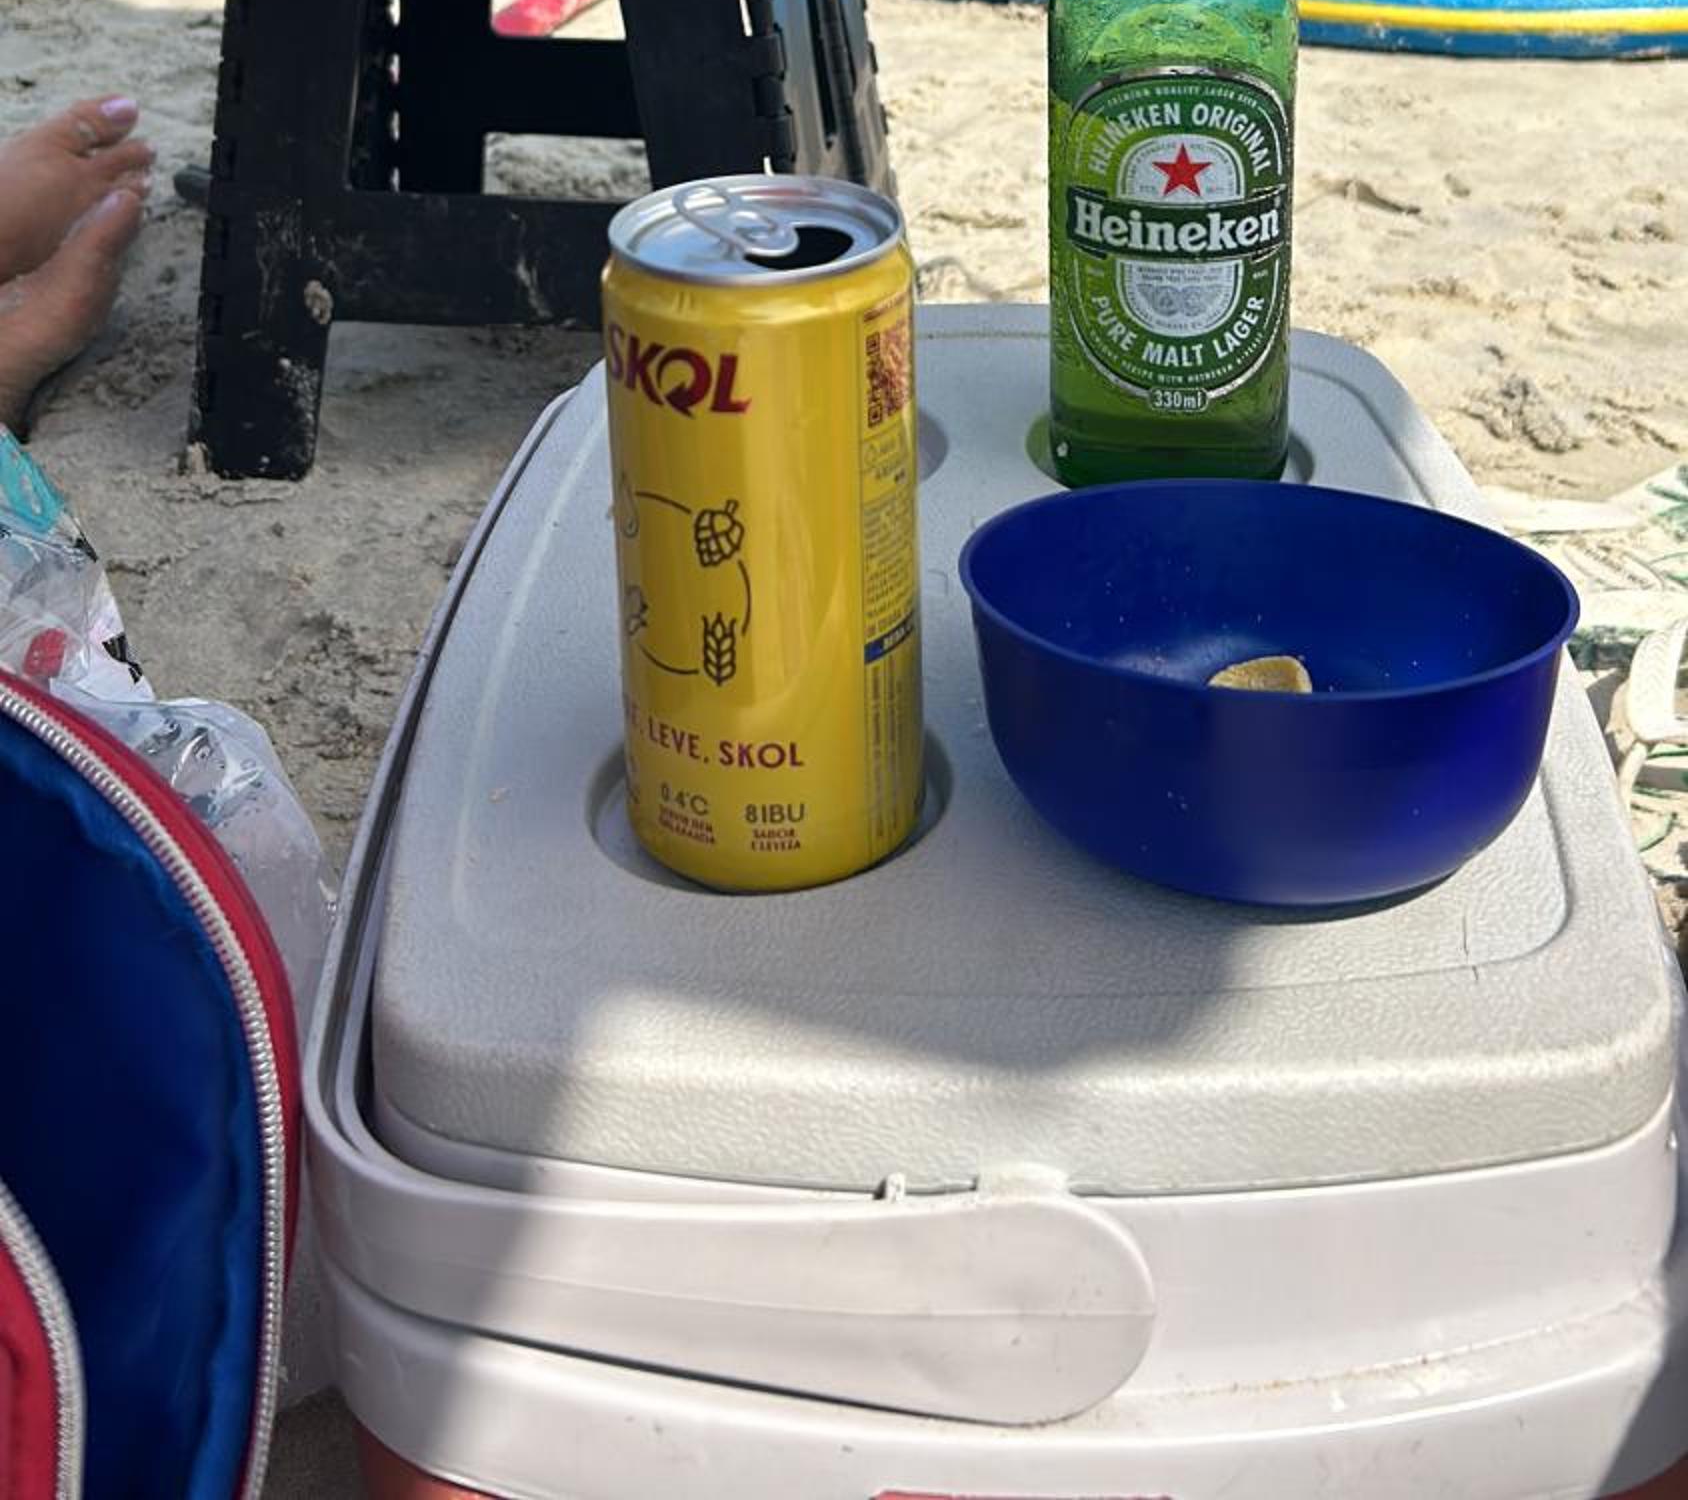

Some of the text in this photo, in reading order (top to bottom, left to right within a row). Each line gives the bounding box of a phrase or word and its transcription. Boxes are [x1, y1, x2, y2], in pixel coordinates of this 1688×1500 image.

[1088, 102, 1181, 176] HEINEKEN
[1191, 103, 1272, 177] ORIGINAL
[1074, 195, 1280, 253] Heineken
[1091, 295, 1138, 351] PURE
[1141, 340, 1204, 368] MALT
[1212, 296, 1265, 359] LAGER
[608, 322, 753, 420] SKOL
[1152, 389, 1202, 410] 330ml
[648, 715, 709, 764] LEVE.
[718, 740, 804, 769] SKOL
[660, 782, 709, 816] 04°C
